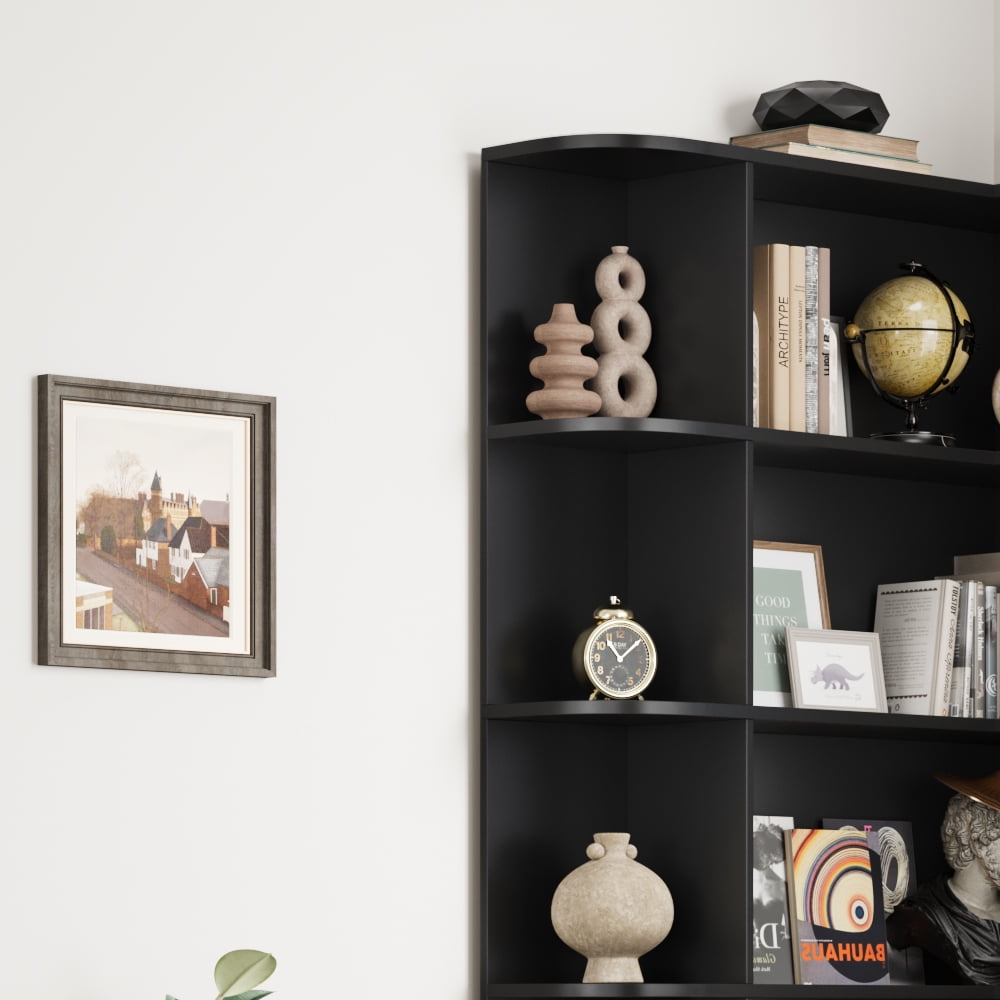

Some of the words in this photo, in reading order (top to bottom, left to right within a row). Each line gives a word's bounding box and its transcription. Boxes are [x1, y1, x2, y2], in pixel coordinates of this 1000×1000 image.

[778, 296, 789, 368] ARCHITYPE
[756, 595, 791, 609] GOOD
[950, 586, 960, 616] TOLSTOY
[753, 614, 798, 627] THINGS
[596, 641, 606, 650] 10
[760, 633, 785, 646] TAK
[594, 653, 600, 662] 9
[597, 666, 604, 675] 8
[605, 675, 611, 684] 7
